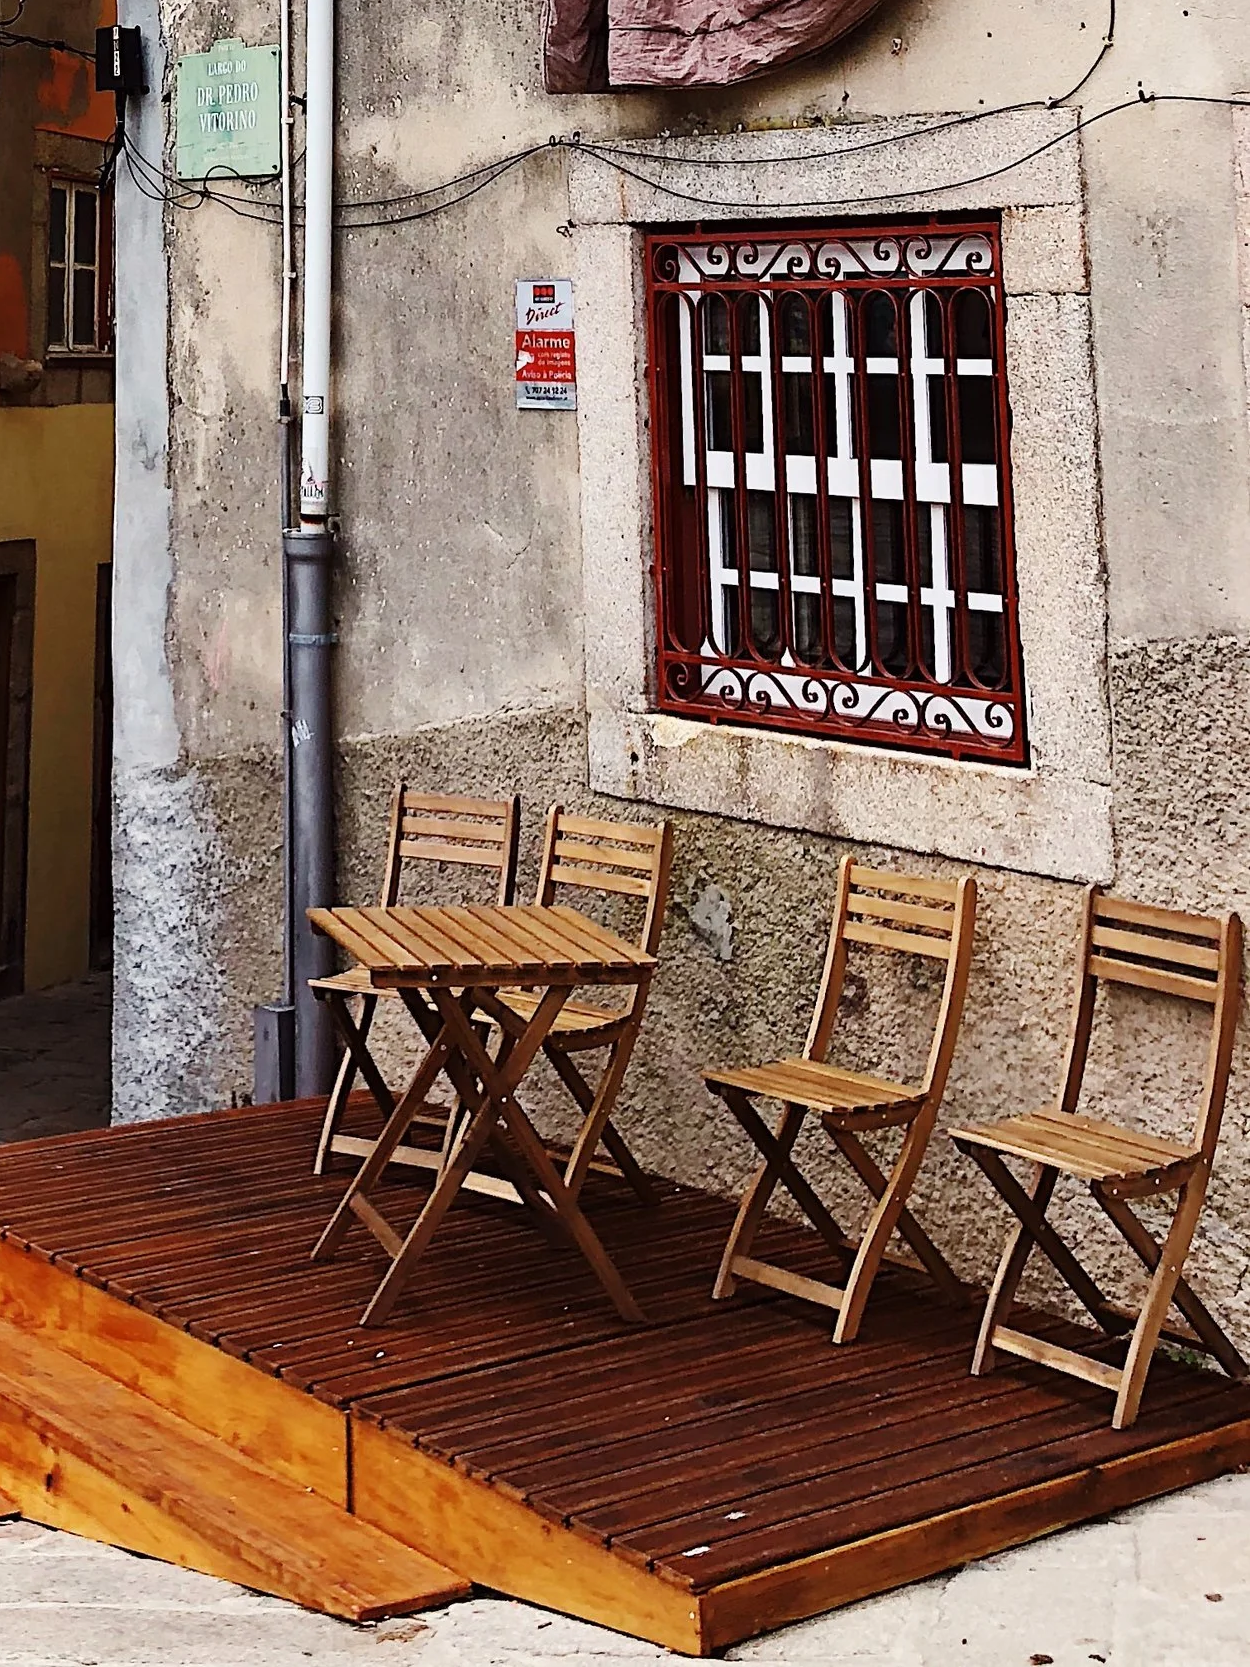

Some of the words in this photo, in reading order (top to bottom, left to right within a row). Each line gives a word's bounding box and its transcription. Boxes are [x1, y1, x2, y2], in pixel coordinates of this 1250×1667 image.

[208, 60, 233, 76] LARGO
[235, 59, 247, 73] DO
[218, 82, 259, 106] PEDRO
[199, 109, 257, 133] VITORINO
[525, 301, 565, 325] Direct
[522, 333, 571, 349] Alarme
[522, 369, 541, 379] Aviso
